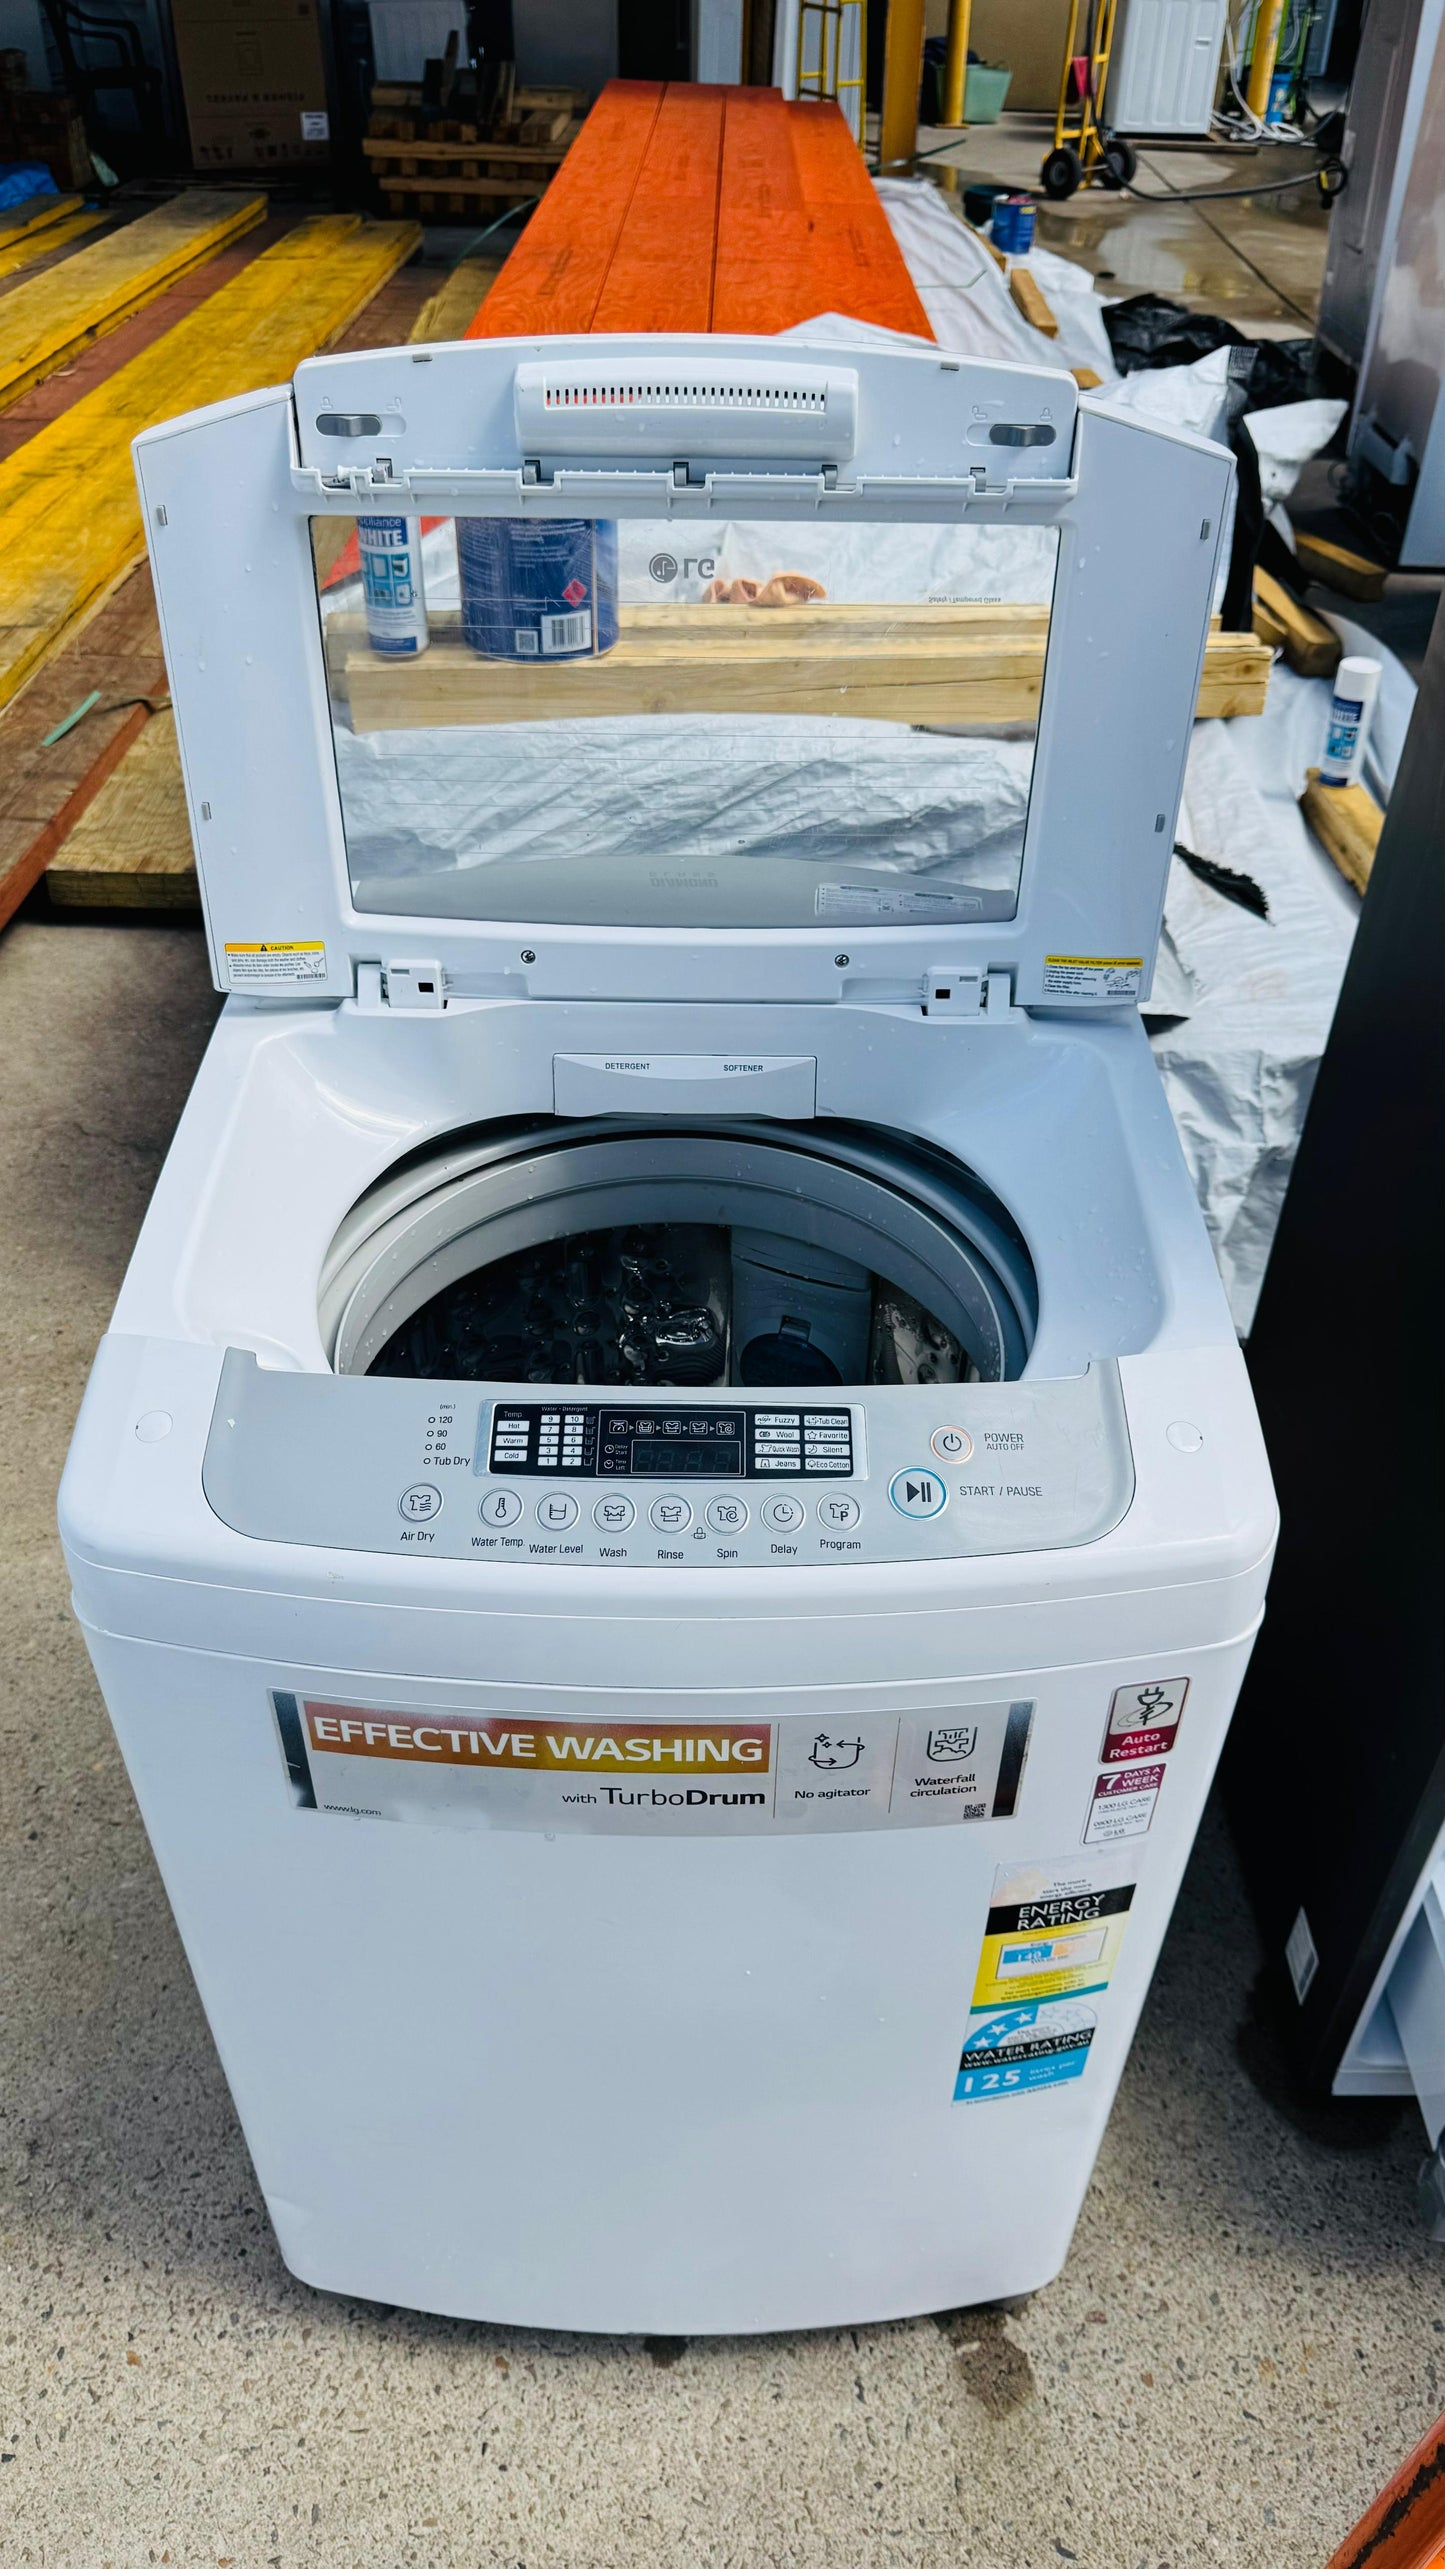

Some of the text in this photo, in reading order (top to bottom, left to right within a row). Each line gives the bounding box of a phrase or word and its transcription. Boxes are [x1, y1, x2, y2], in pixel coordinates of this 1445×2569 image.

[723, 1064, 764, 1072] SOFTENER
[439, 1416, 453, 1424] 120
[437, 1430, 448, 1438] 90
[984, 1433, 1024, 1443] POWER
[435, 1443, 447, 1451] 60
[986, 1443, 1024, 1451] AUTO OFF
[434, 1456, 471, 1467] Tub Dry
[959, 1486, 995, 1496] START
[1006, 1486, 1043, 1497] PAUSE
[400, 1531, 435, 1542] Air Dry
[471, 1537, 525, 1548] Water Temp.
[819, 1539, 861, 1550] Program
[529, 1544, 584, 1554] Water Level
[599, 1548, 627, 1557] Wash
[657, 1549, 684, 1559] Rinse
[716, 1548, 738, 1559] Spin
[770, 1544, 798, 1555] Delay
[313, 1716, 764, 1762] EFFECTIVE WASHING
[1121, 1733, 1161, 1746] Auto
[1109, 1741, 1168, 1759] Restart
[914, 1773, 976, 1786] Waterfall
[1102, 1766, 1161, 1790] 7 DAYS A
[1121, 1775, 1159, 1787] WEEK
[561, 1787, 765, 1806] with TurboDrum
[794, 1787, 871, 1800] No agitator
[909, 1784, 977, 1798] circulation
[1098, 1786, 1138, 1797] CUSTOMER
[1131, 1796, 1151, 1805] CARE
[323, 1803, 382, 1816] www.lg.com
[1019, 1893, 1105, 1919] ENERGY
[1017, 1907, 1101, 1931] RATING
[965, 2047, 1025, 2062] WATER
[1029, 2030, 1092, 2050] RATING
[964, 2069, 1021, 2093] 125
